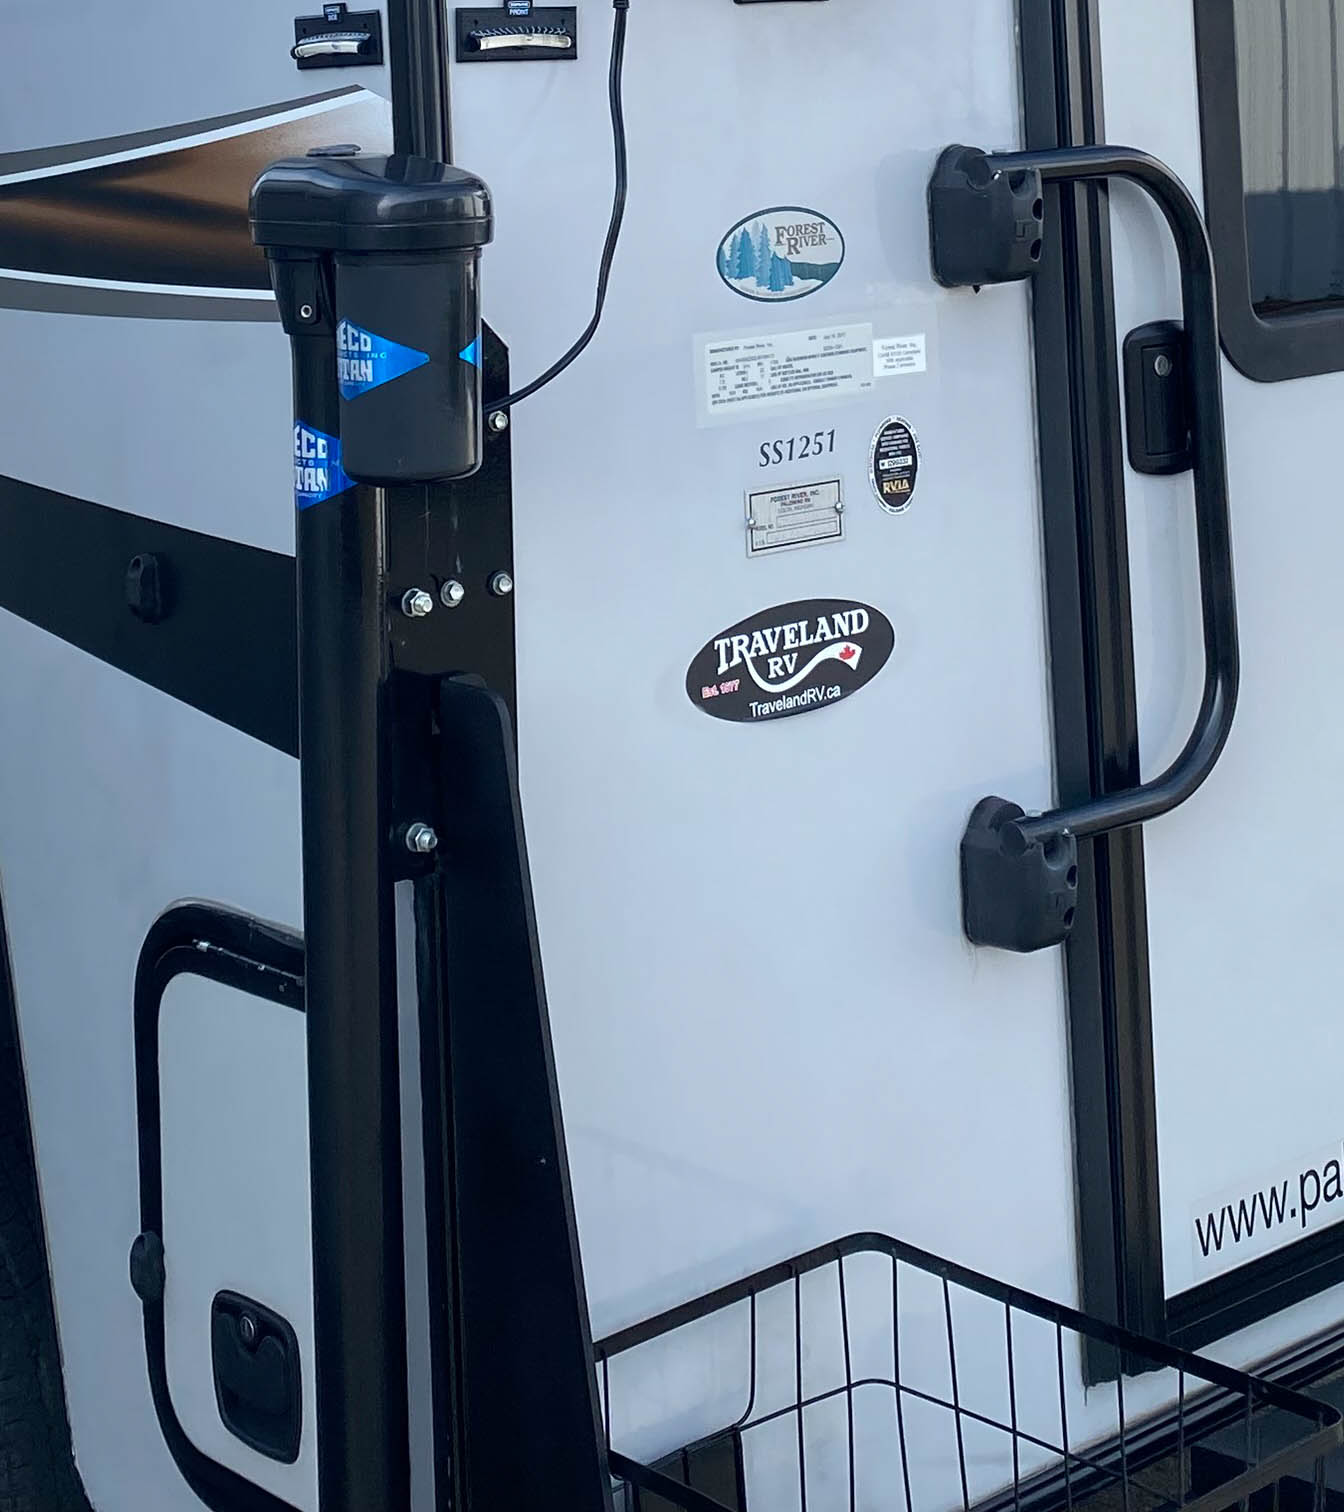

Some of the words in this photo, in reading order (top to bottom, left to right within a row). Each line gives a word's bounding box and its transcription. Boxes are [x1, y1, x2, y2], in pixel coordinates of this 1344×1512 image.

[774, 222, 826, 247] FOREST
[786, 234, 827, 256] RIVER
[759, 429, 835, 468] SS1251
[883, 479, 909, 494] RVIA
[714, 608, 870, 676] TRAVELAND
[767, 652, 799, 679] RV
[749, 685, 841, 718] TravelandRV.ca
